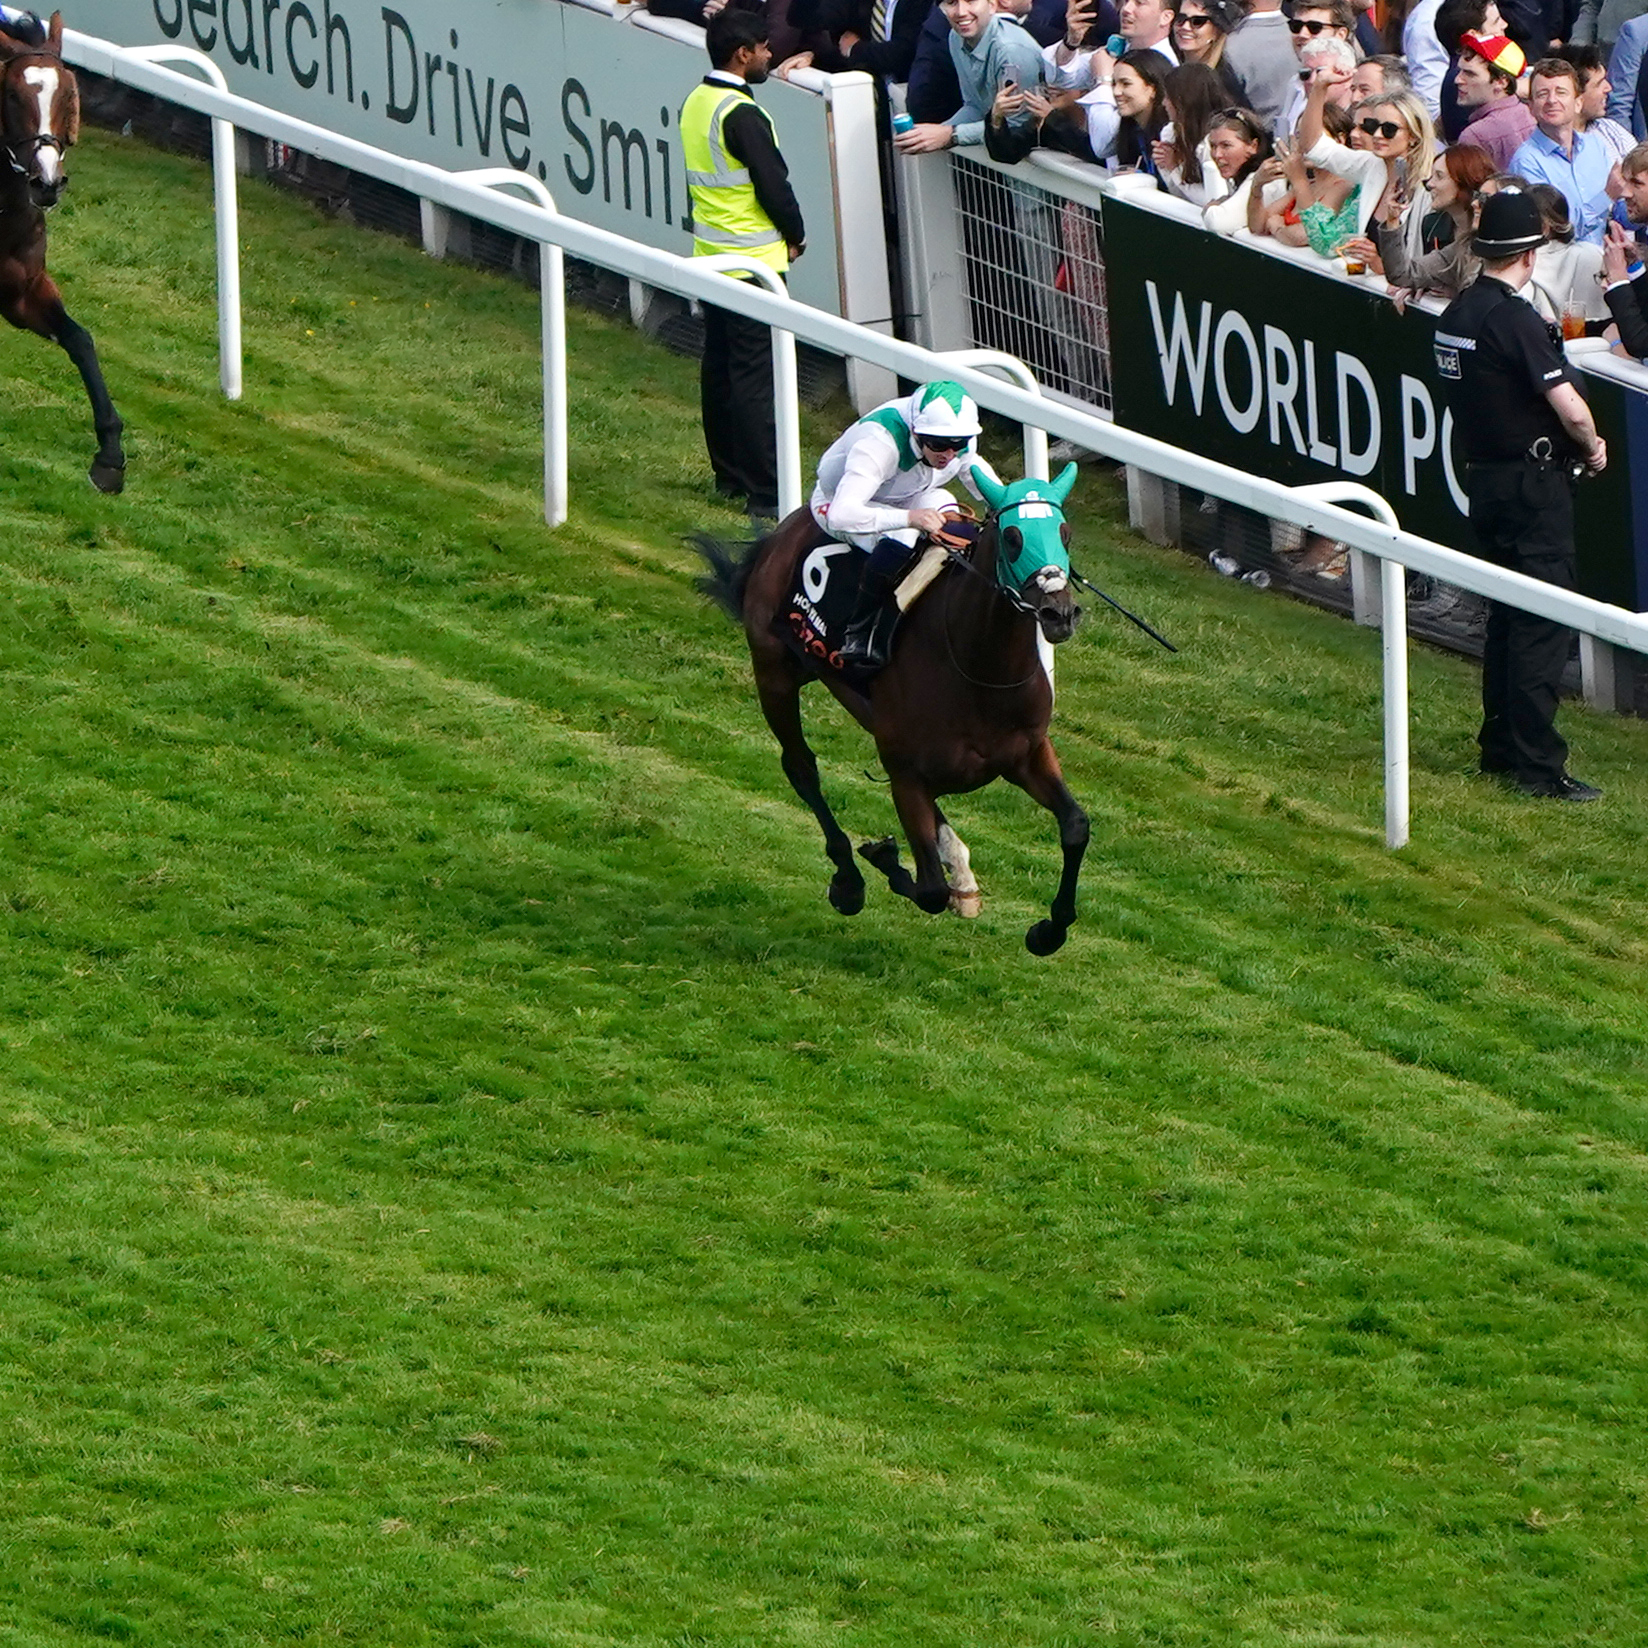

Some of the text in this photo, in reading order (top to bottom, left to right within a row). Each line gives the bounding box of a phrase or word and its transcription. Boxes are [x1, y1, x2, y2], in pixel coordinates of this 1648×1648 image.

[380, 5, 549, 181] Drive.
[1145, 278, 1382, 477] WORLD
[802, 542, 853, 604] 6
